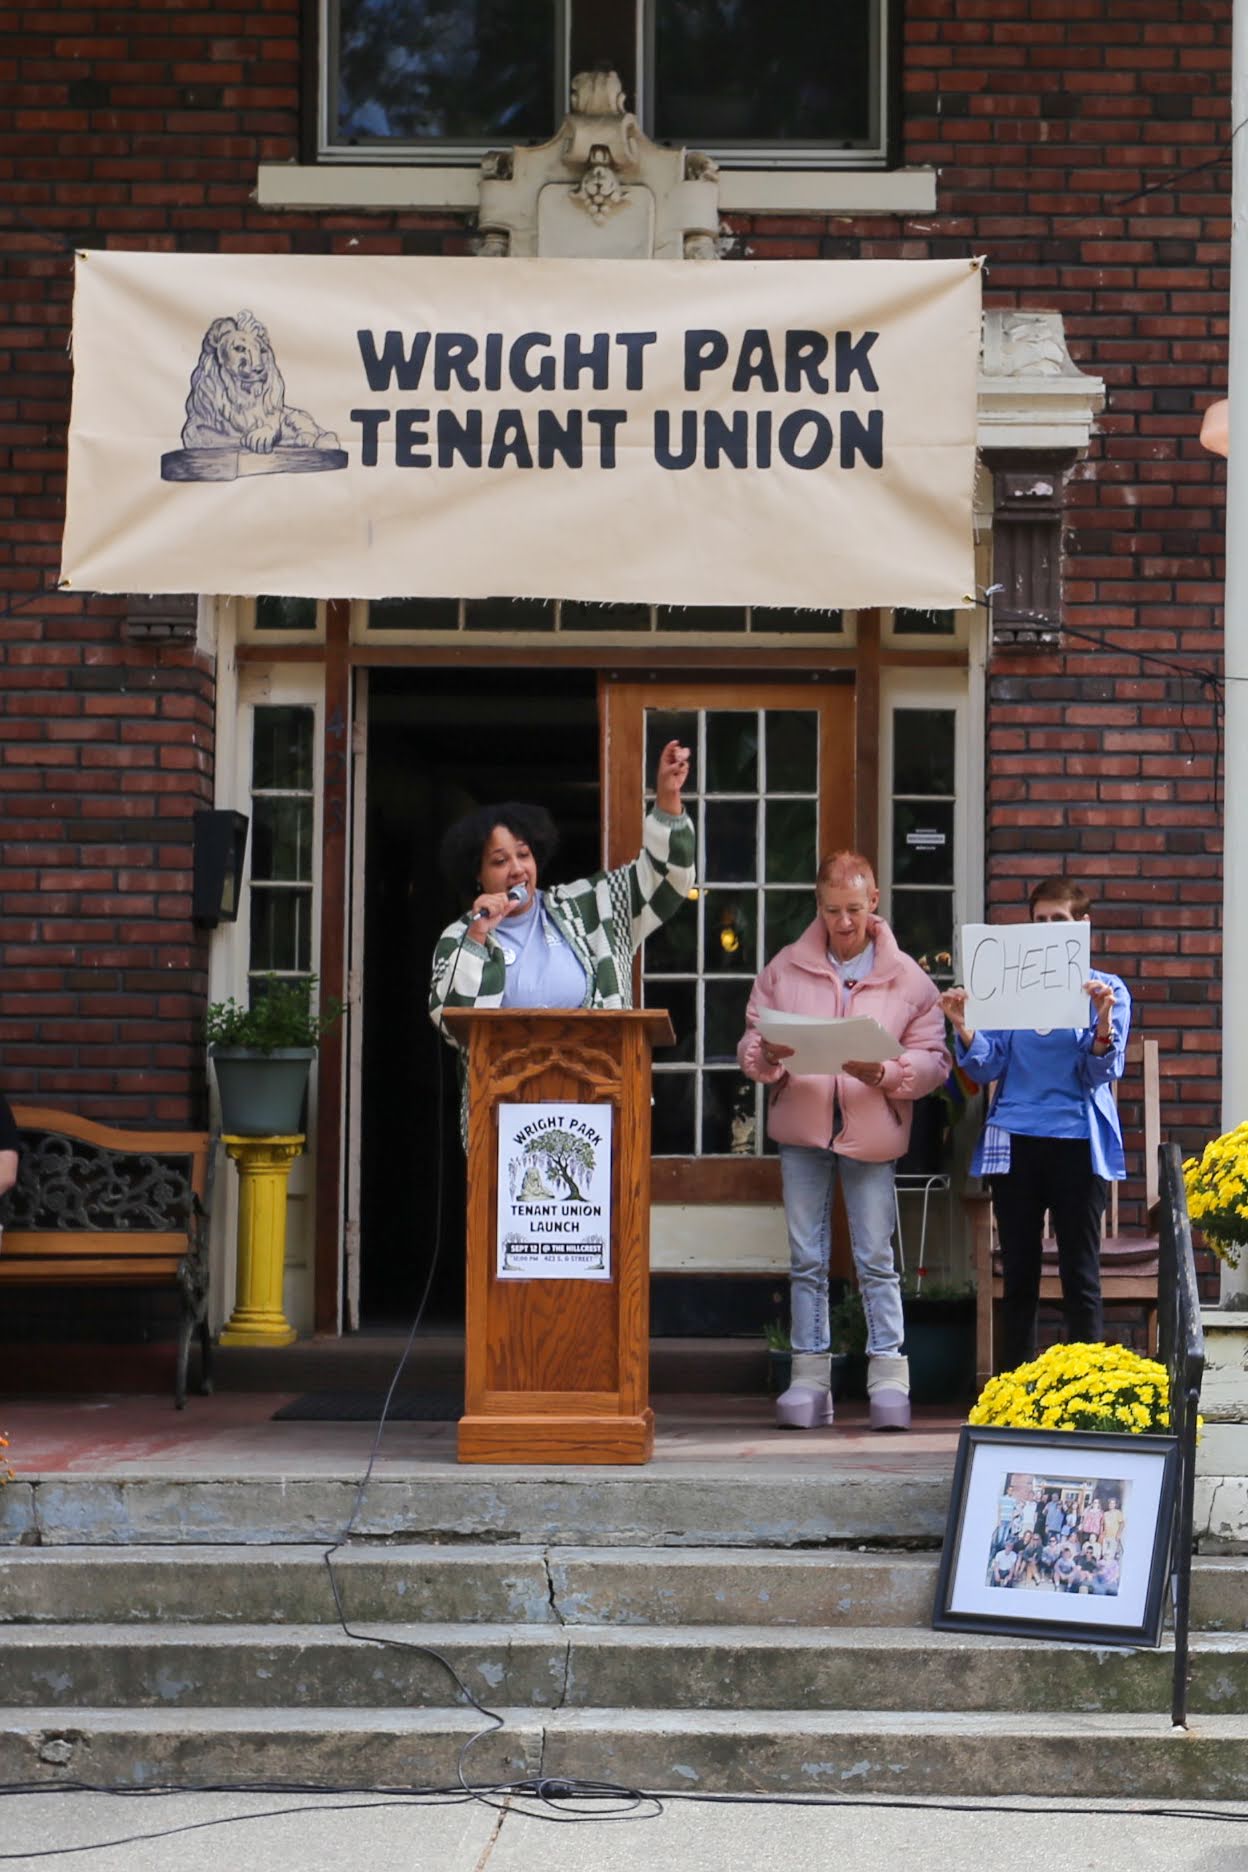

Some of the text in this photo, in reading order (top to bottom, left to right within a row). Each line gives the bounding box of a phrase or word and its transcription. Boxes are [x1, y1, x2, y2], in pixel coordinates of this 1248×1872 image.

[357, 329, 880, 395] WRIGHT PARK
[350, 409, 884, 470] TENANT UNION
[970, 937, 1083, 1001] CHEER
[513, 1116, 603, 1146] WRIGHT PARK
[510, 1205, 602, 1216] TENANT UNION
[530, 1221, 580, 1233] LAUNCH
[510, 1244, 528, 1253] SEPT
[529, 1244, 538, 1253] 12
[551, 1244, 565, 1253] THE
[566, 1244, 602, 1253] HILLCREST
